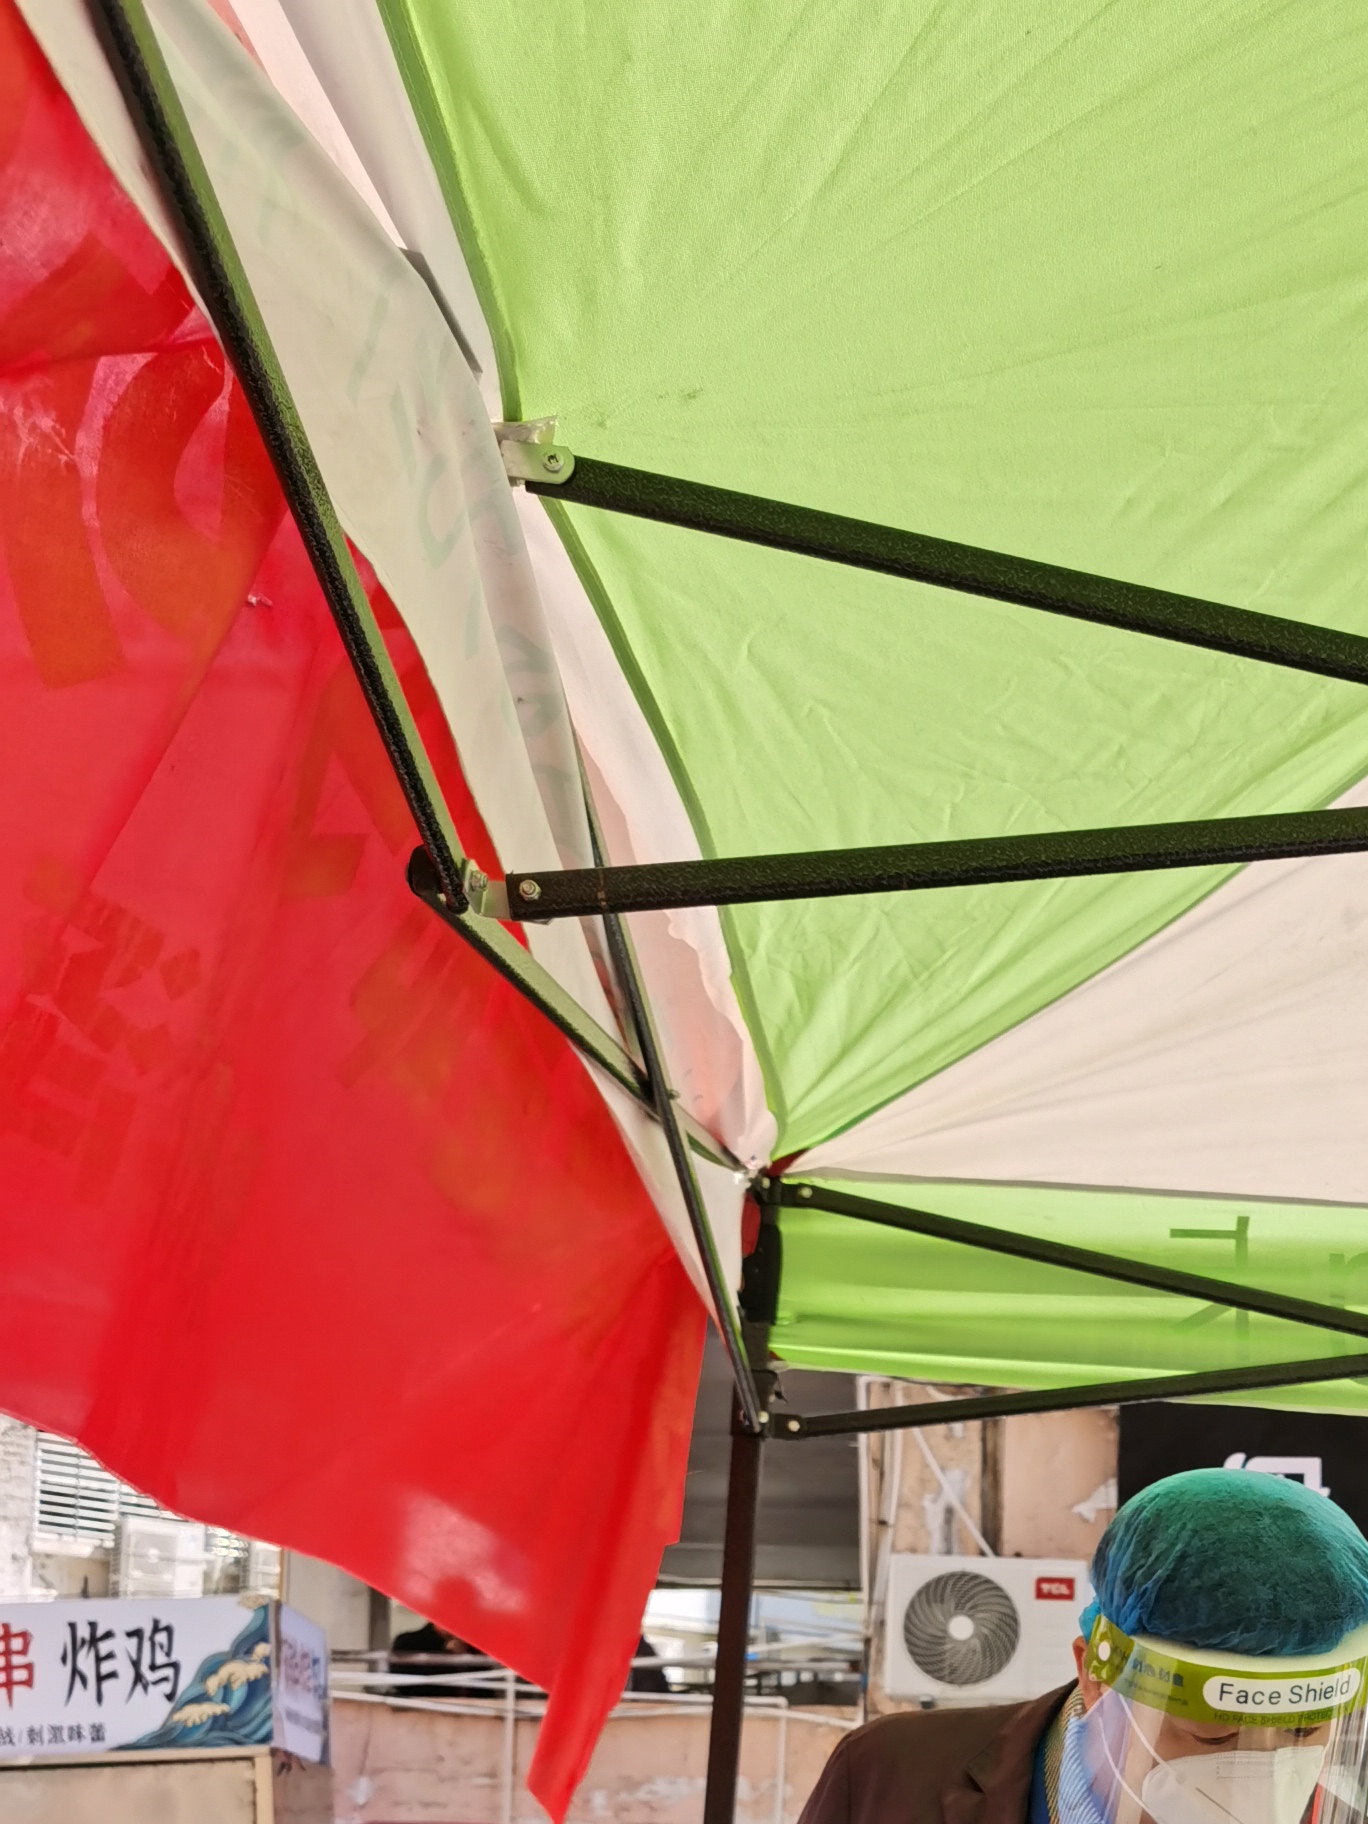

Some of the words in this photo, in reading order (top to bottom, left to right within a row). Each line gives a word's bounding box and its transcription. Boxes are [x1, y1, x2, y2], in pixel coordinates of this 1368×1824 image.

[61, 1616, 181, 1707] 炸鸡
[1219, 1682, 1282, 1705] Face
[1288, 1674, 1352, 1704] Shield
